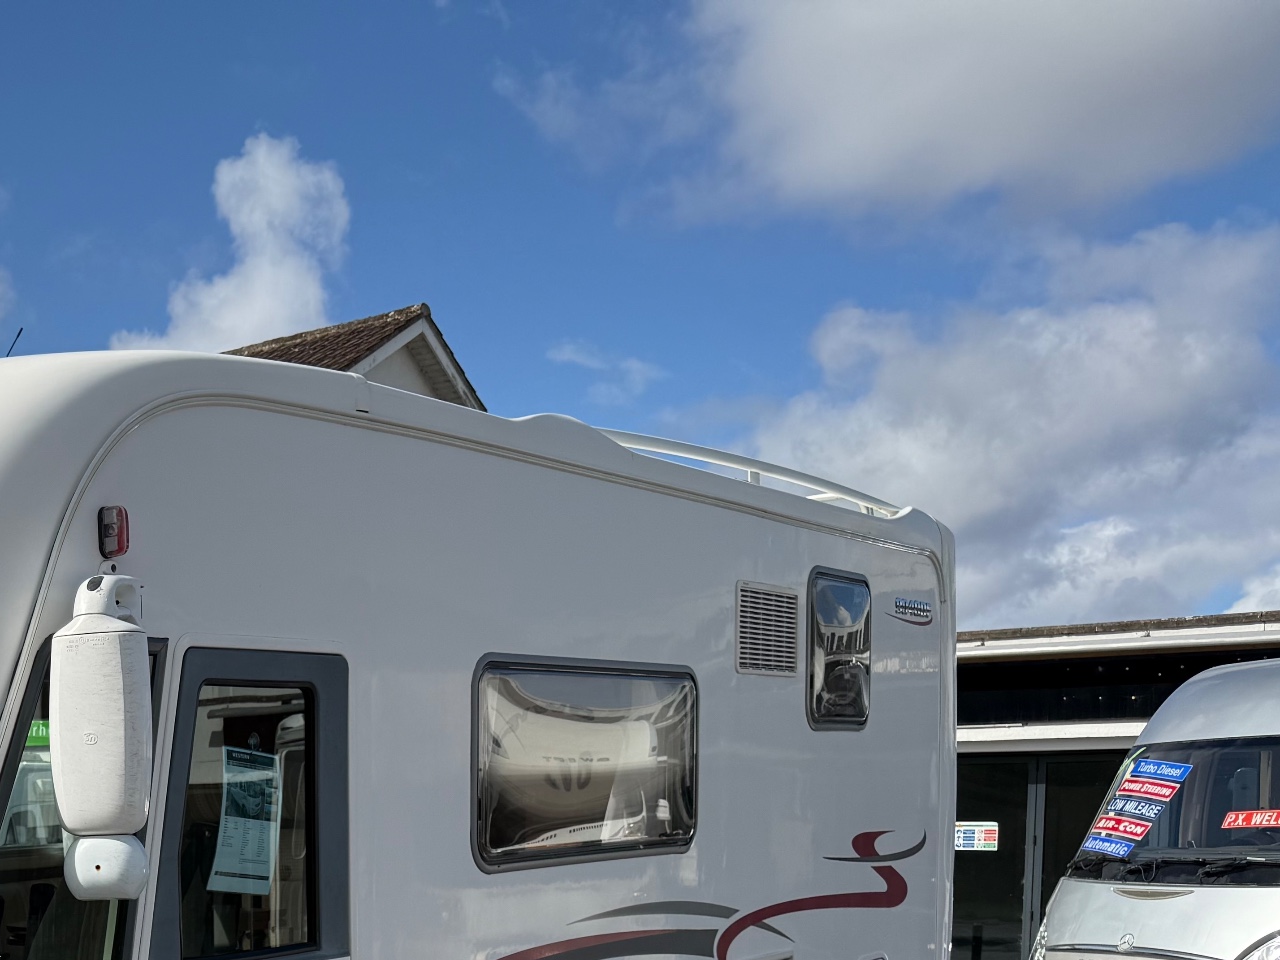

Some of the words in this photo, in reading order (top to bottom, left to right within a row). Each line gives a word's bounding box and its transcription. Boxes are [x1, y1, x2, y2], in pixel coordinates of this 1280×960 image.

[1138, 762, 1158, 774] Turbo
[1157, 764, 1185, 777] Diesel
[1108, 799, 1124, 810] LOW
[1123, 801, 1161, 818] MILEAGE
[1224, 813, 1247, 826] P.X.
[1251, 812, 1280, 825] WEL
[1083, 838, 1128, 855] Automatic
